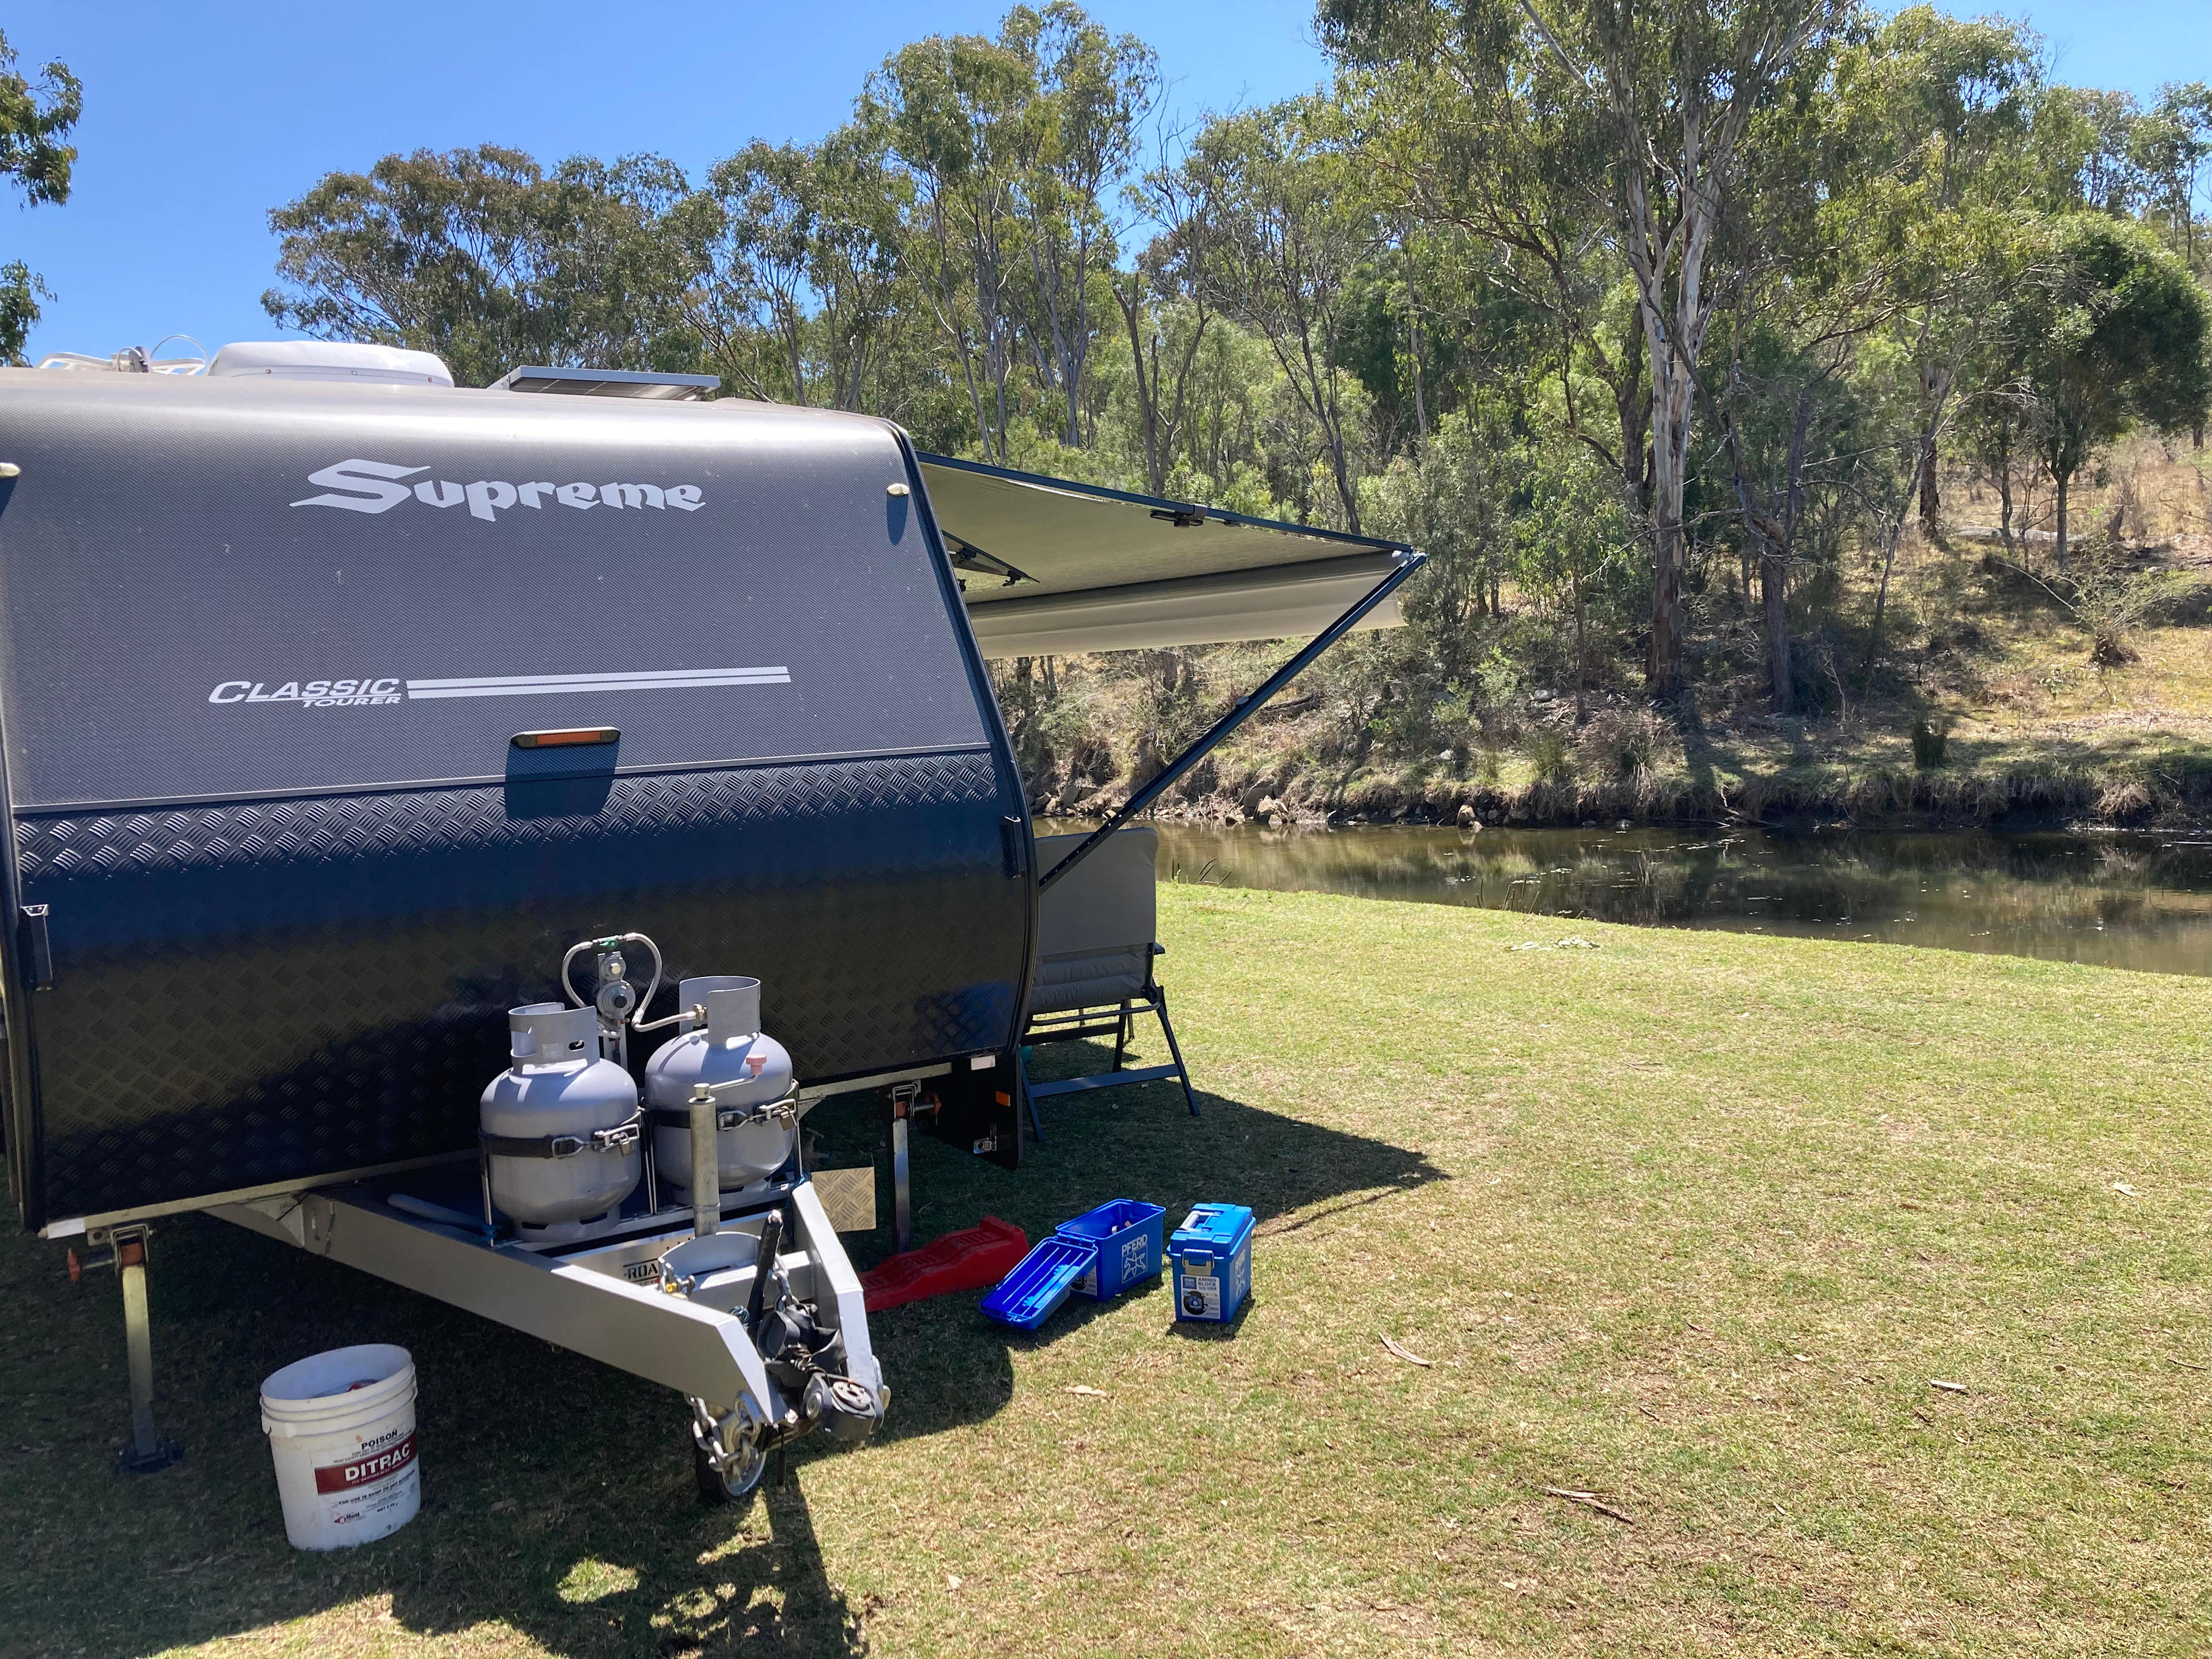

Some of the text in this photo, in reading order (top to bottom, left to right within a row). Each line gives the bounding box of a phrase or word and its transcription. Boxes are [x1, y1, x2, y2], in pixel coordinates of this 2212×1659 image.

[289, 459, 706, 522] Supreme
[208, 678, 400, 703] CLASSIC
[302, 696, 401, 707] TOURER
[1122, 1233, 1148, 1256] PFERD
[362, 1429, 397, 1450] POISON
[345, 1442, 410, 1482] DITRAC
